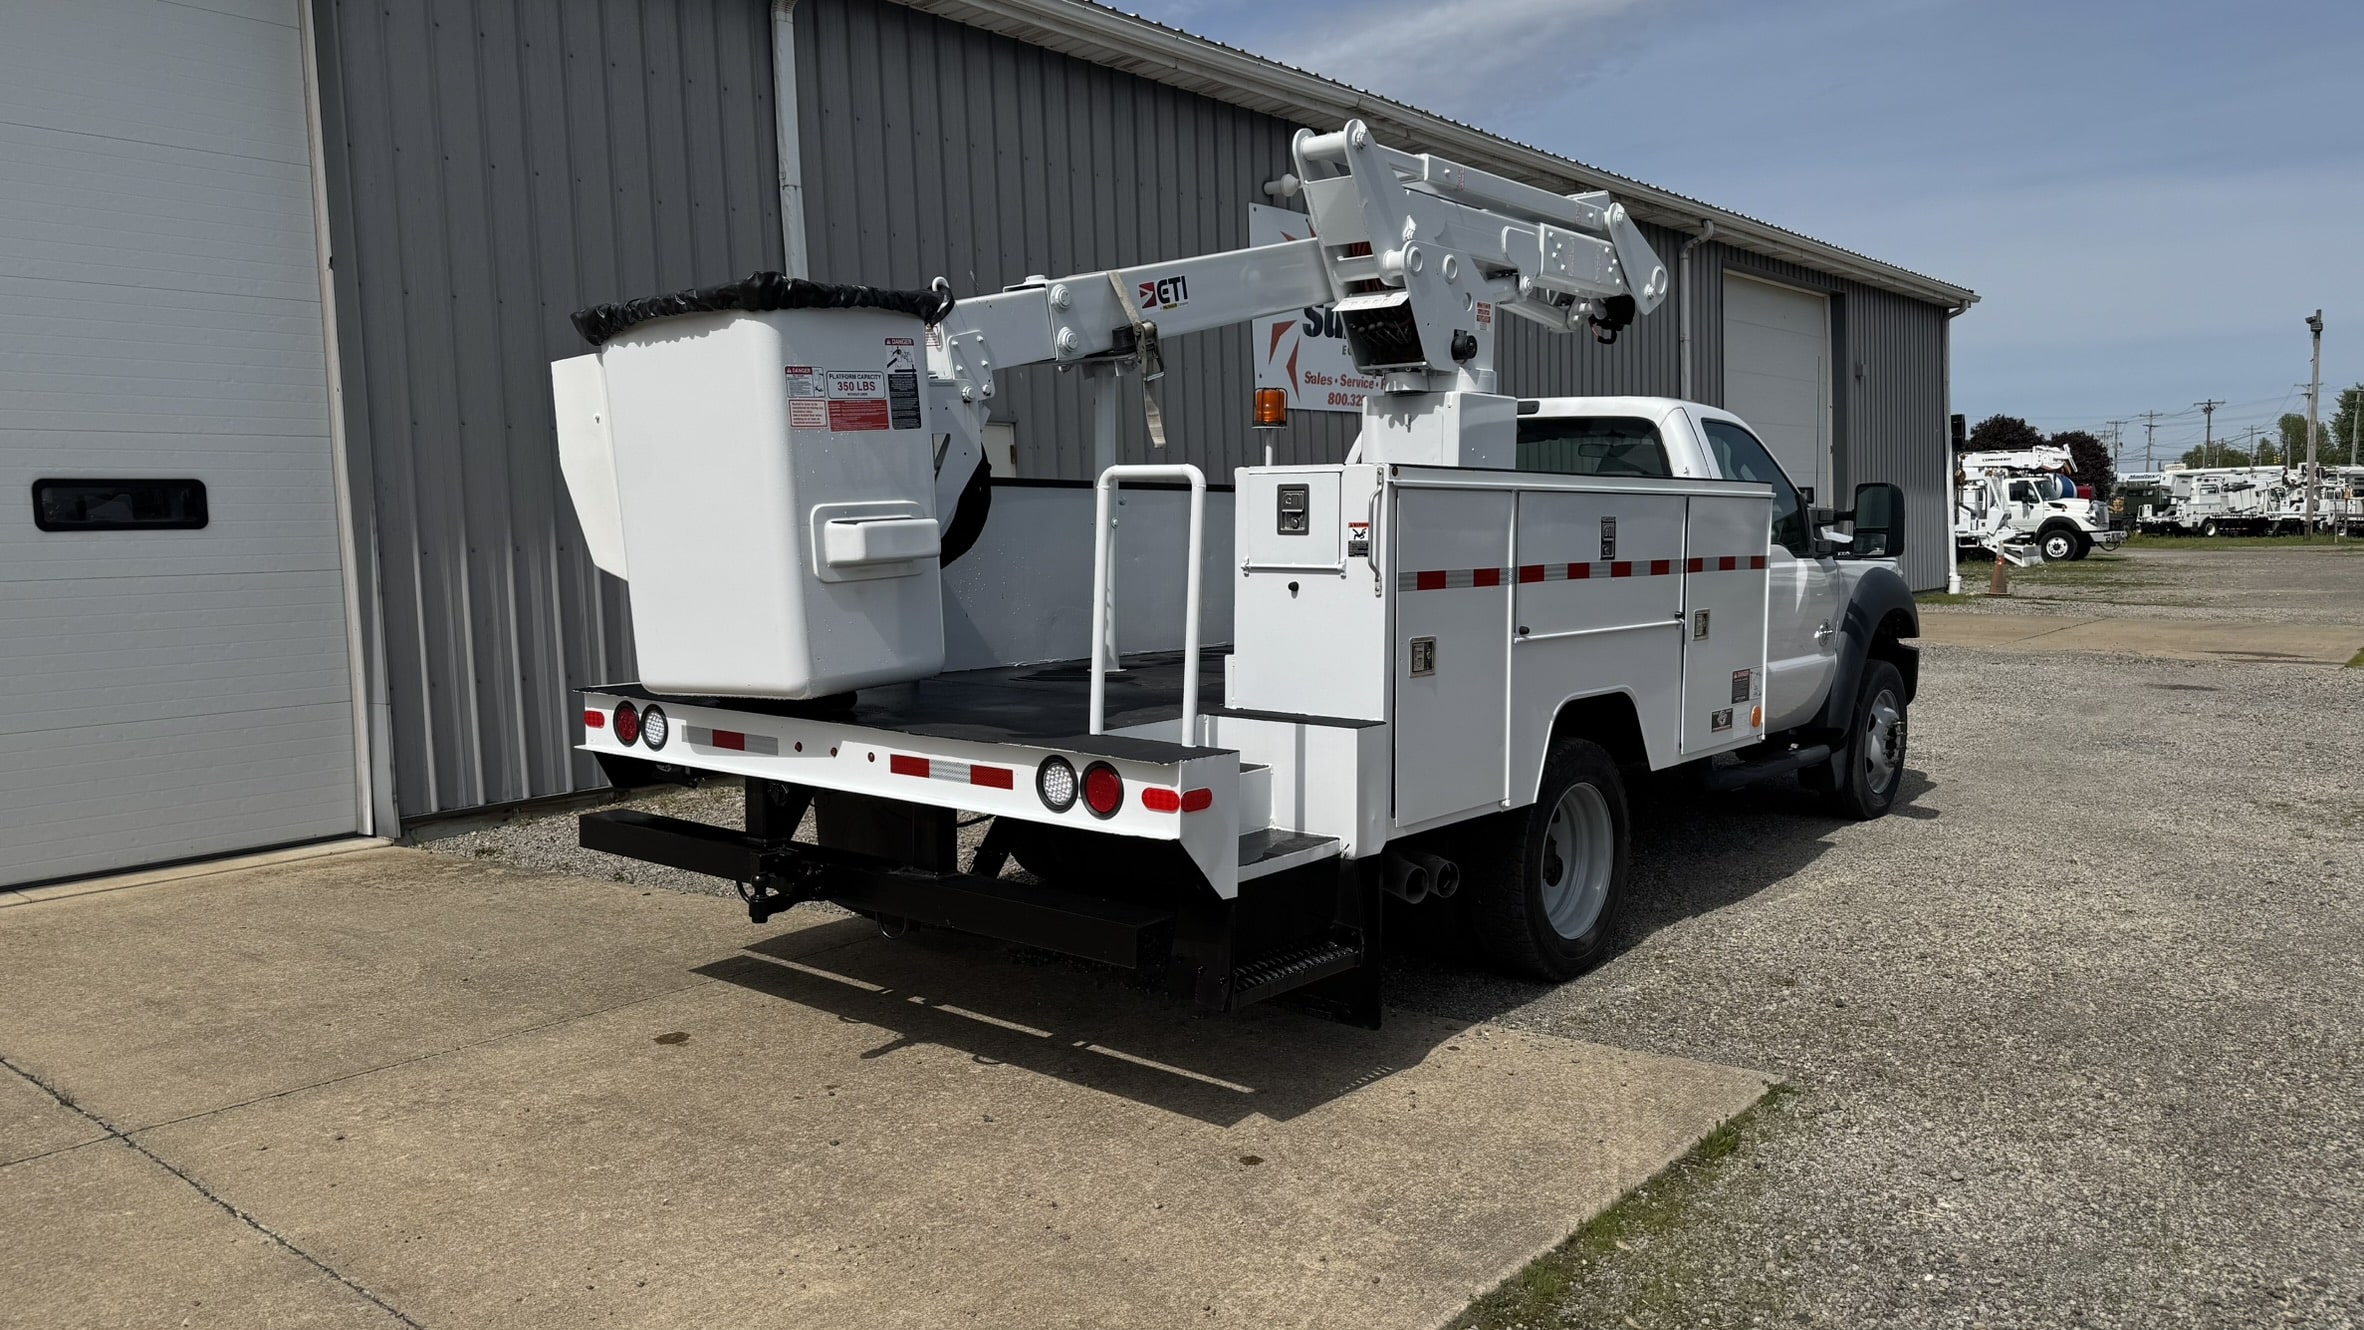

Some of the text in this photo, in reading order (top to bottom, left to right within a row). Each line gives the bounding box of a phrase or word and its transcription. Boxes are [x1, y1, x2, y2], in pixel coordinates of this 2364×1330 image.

[1157, 275, 1188, 304] ETI
[837, 381, 876, 391] 350 LBS
[1304, 371, 1333, 386] Sales
[1340, 374, 1375, 390] Service
